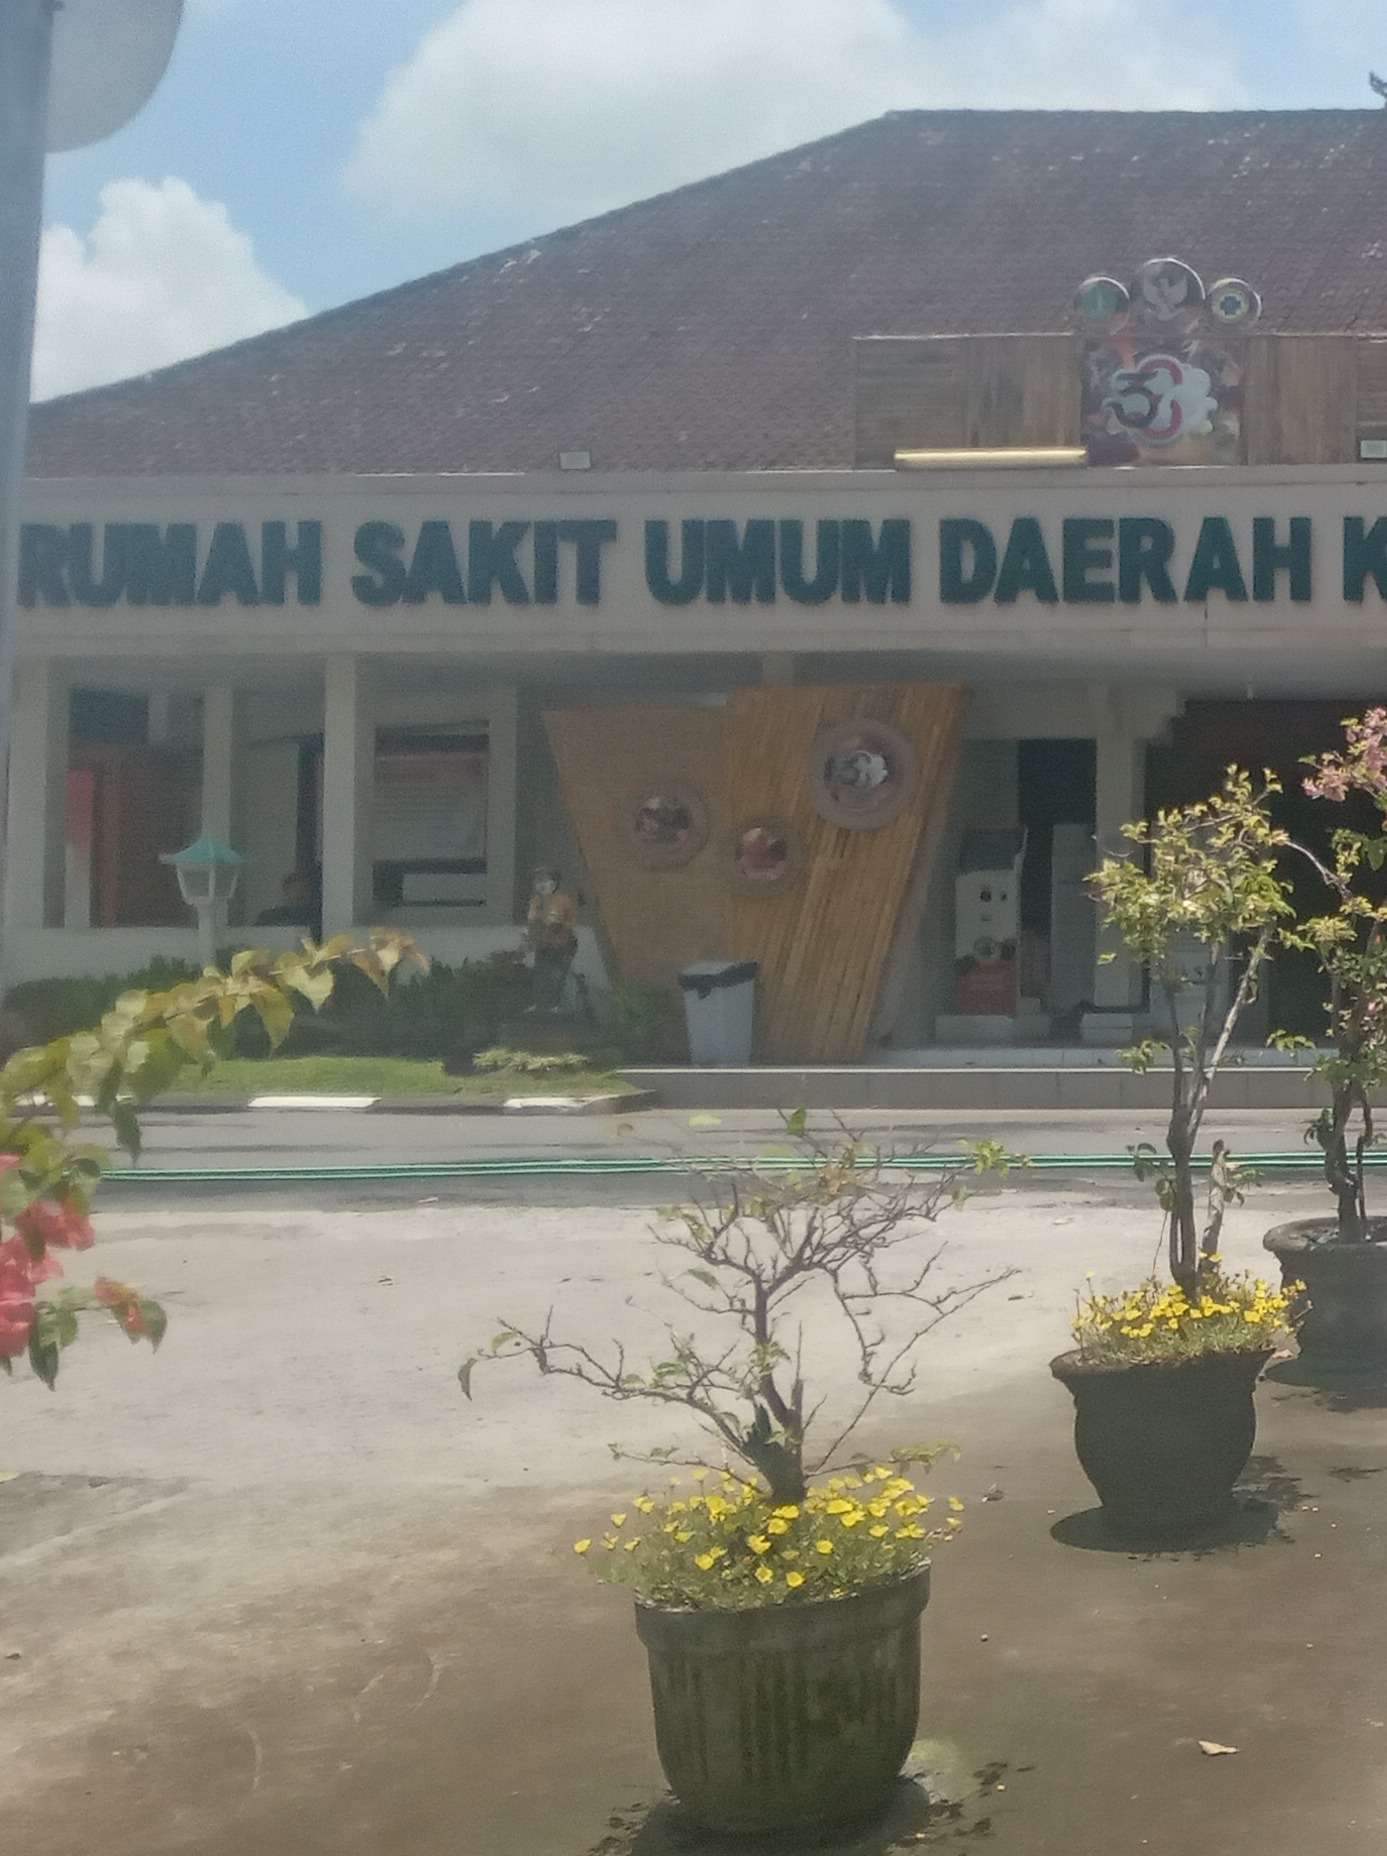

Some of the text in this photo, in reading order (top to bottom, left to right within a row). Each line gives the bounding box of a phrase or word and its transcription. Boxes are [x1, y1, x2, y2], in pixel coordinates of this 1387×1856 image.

[17, 520, 323, 607] RUMAH
[350, 519, 617, 607] SAKIT
[644, 518, 911, 606] UMUM
[938, 517, 1312, 604] DAERAH
